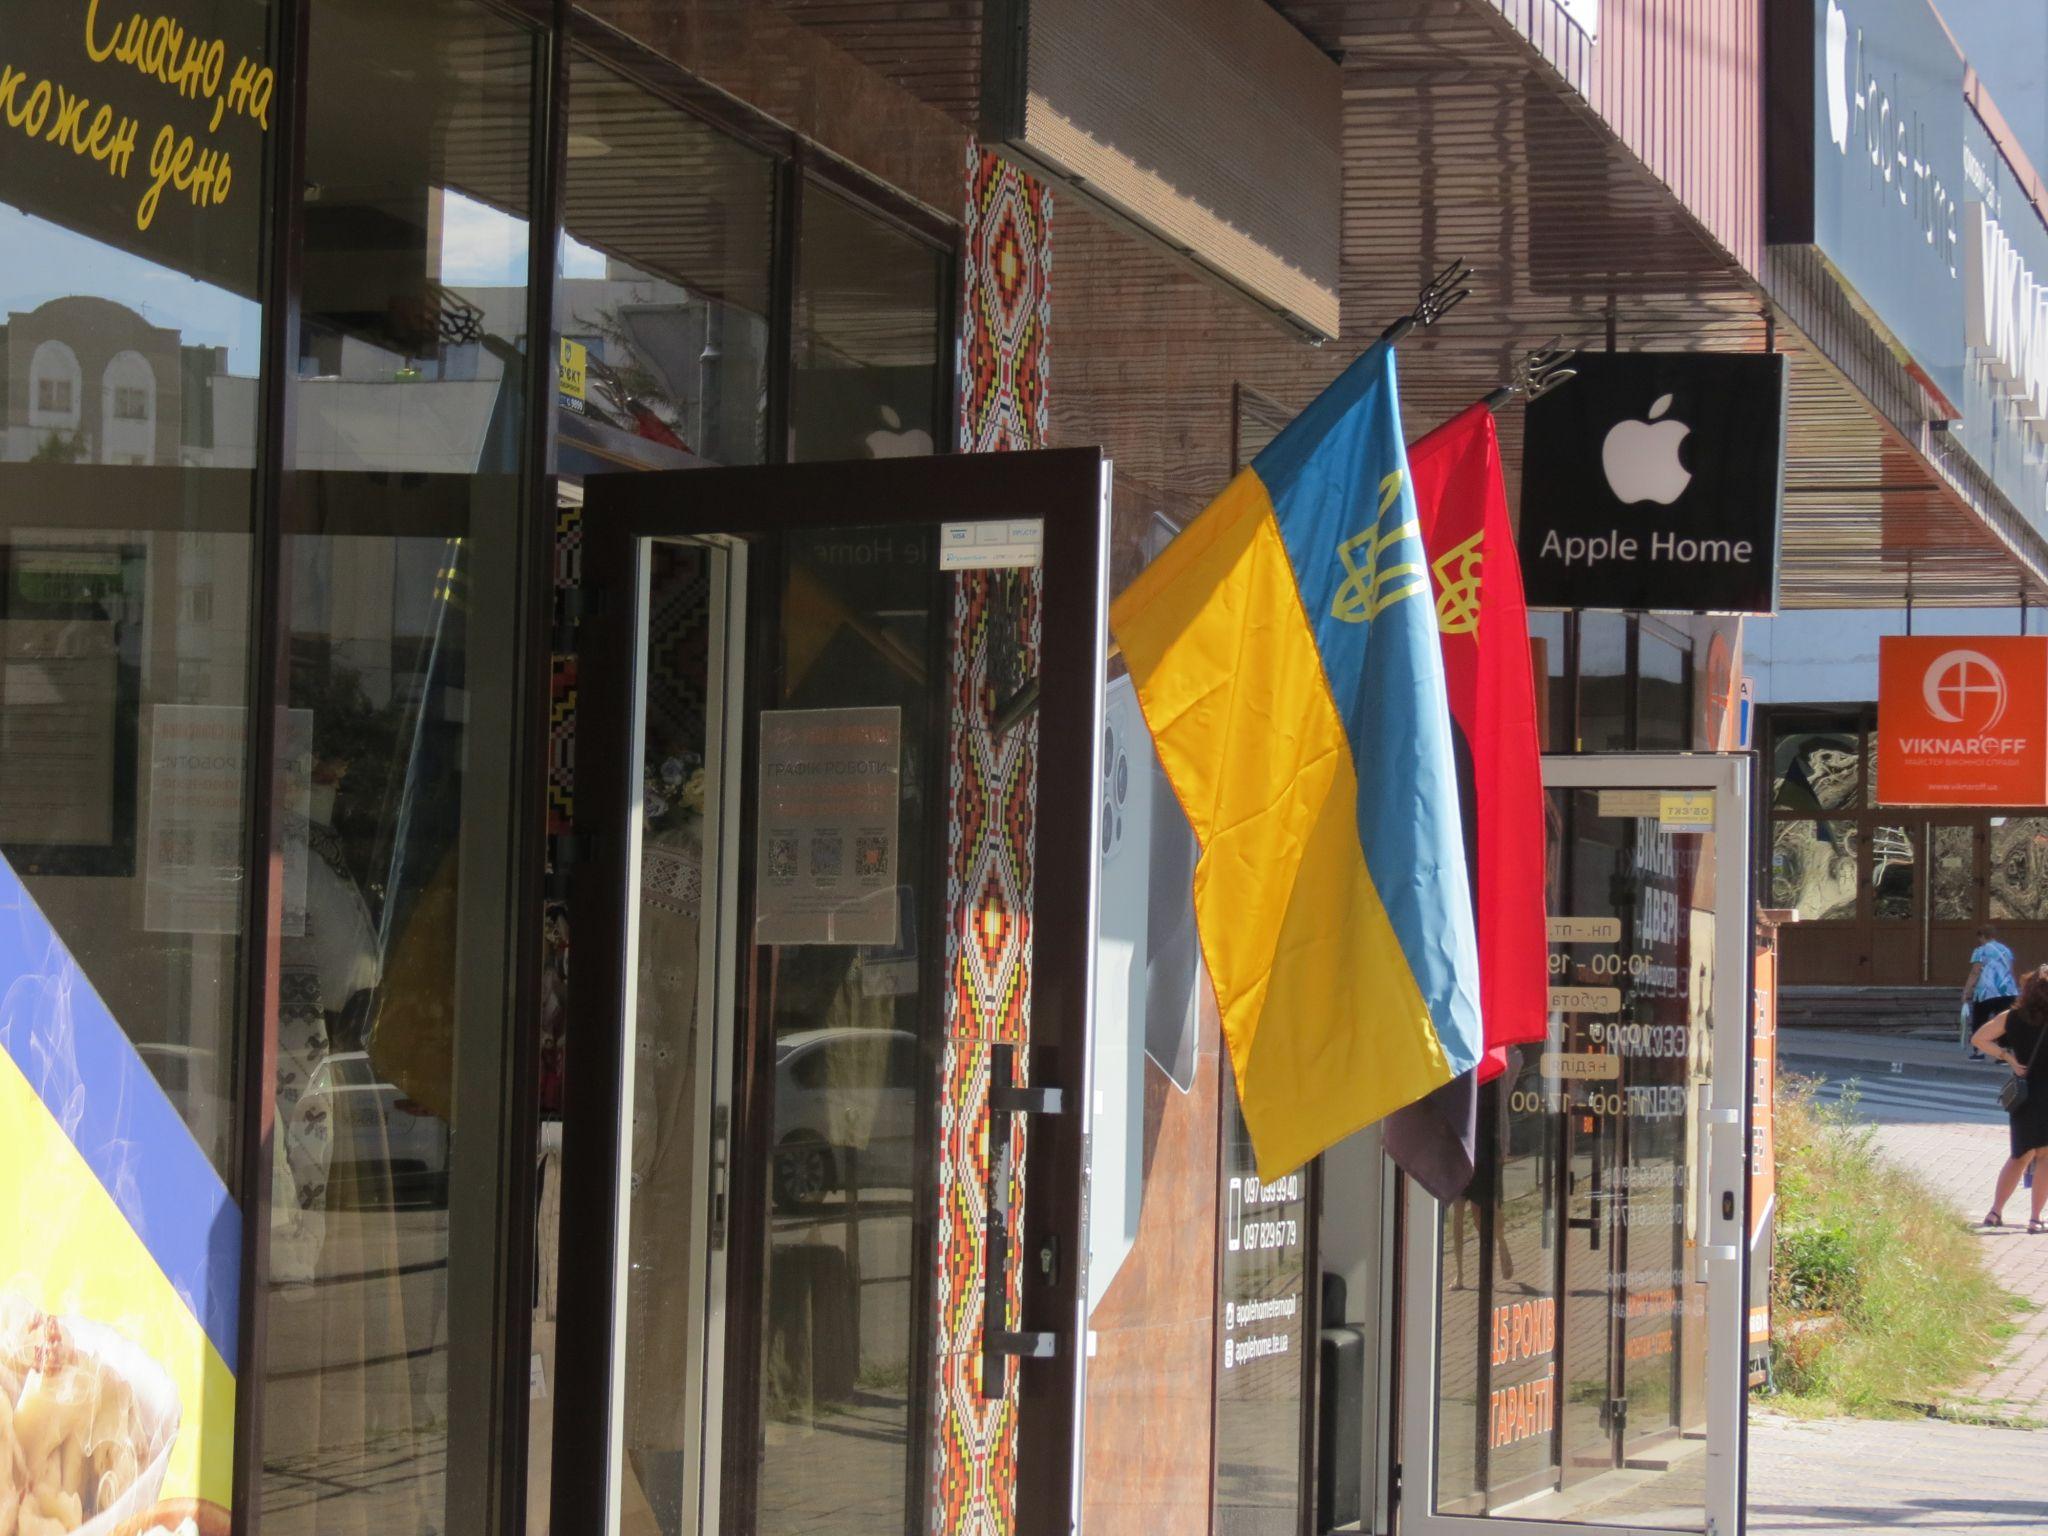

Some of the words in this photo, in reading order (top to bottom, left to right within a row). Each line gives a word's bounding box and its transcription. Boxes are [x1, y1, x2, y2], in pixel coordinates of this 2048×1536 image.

[137, 124, 232, 231] день
[1540, 530, 1638, 567] Apple
[1651, 532, 1753, 563] Home
[1244, 1177, 1260, 1204] 097
[1287, 1175, 1297, 1201] 40
[1243, 1223, 1259, 1250] 097
[1260, 1221, 1275, 1249] 829
[1275, 1221, 1285, 1248] 67
[1286, 1220, 1296, 1246] 79
[1491, 1305, 1510, 1367] 15
[1511, 1297, 1556, 1362] РОКІВ
[1490, 1361, 1556, 1450] ГАРАНТІЇ
